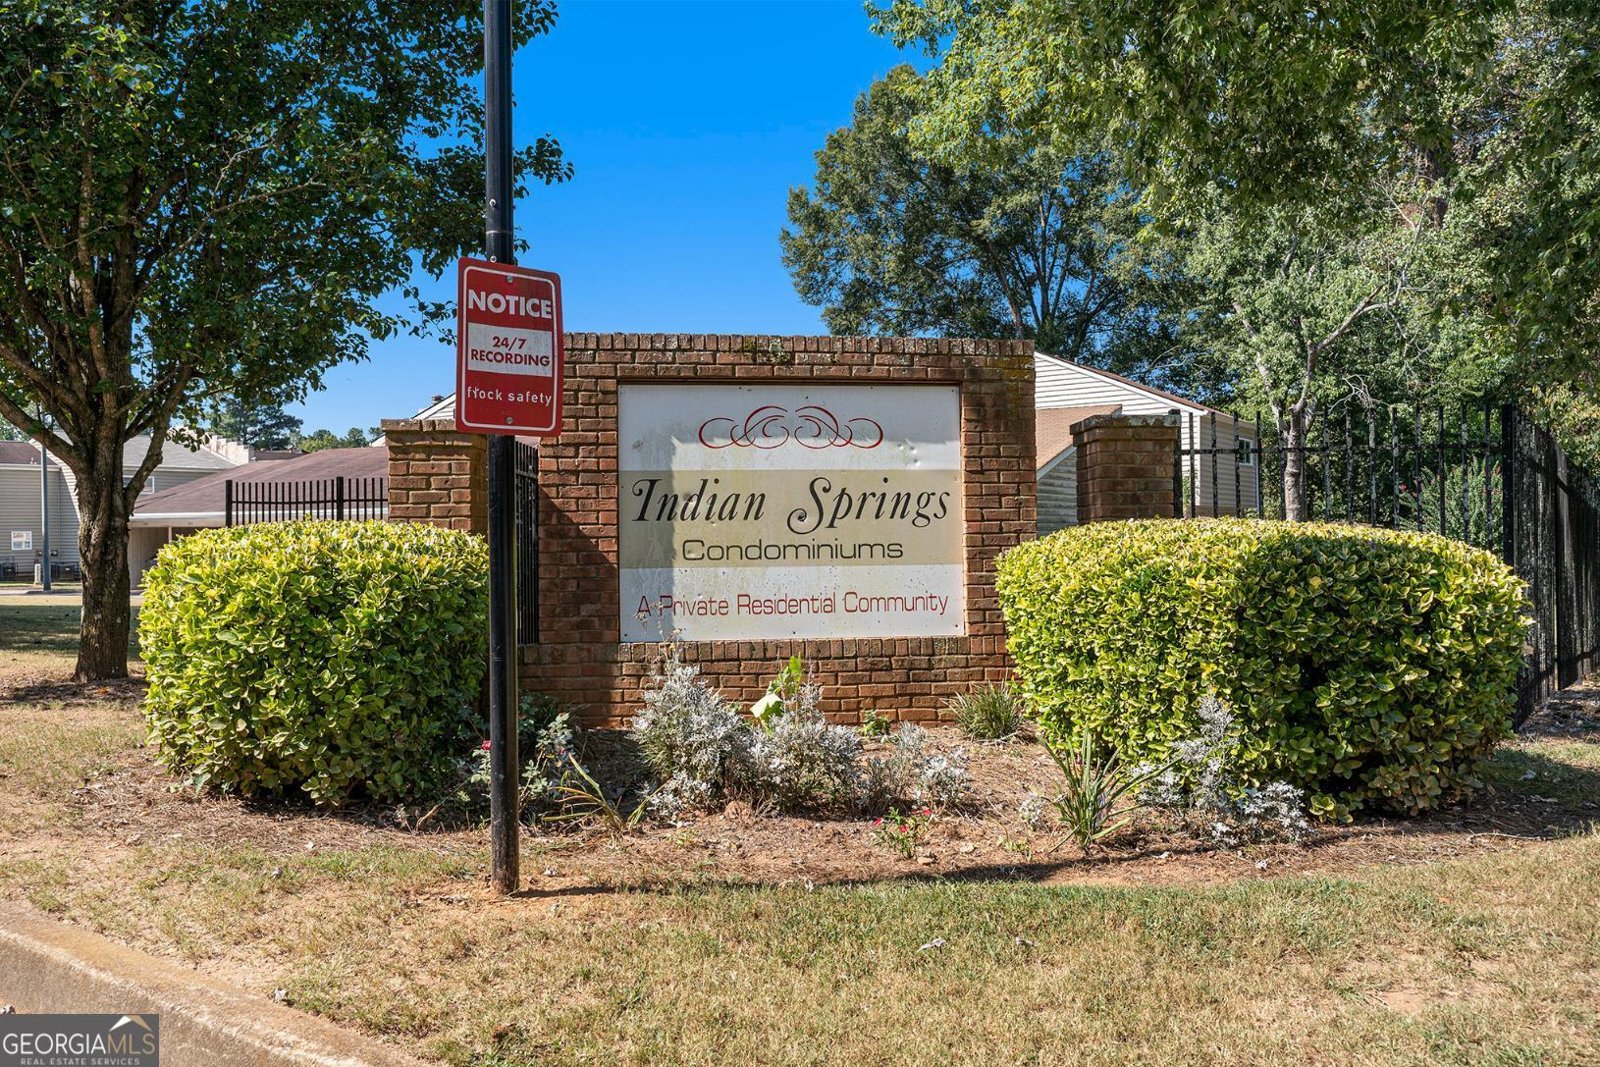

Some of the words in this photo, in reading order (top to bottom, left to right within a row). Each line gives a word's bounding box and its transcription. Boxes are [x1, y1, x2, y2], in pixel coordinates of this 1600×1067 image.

[468, 289, 552, 319] NOTICE
[492, 336, 527, 351] 24/7
[470, 348, 550, 367] RECORDING
[507, 391, 552, 407] safety
[631, 478, 767, 522] Indian
[786, 477, 950, 535] Springs
[682, 538, 904, 561] Condominiums
[636, 595, 652, 617] A
[659, 594, 729, 616] Private
[737, 592, 836, 616] Residential
[844, 591, 949, 616] Community
